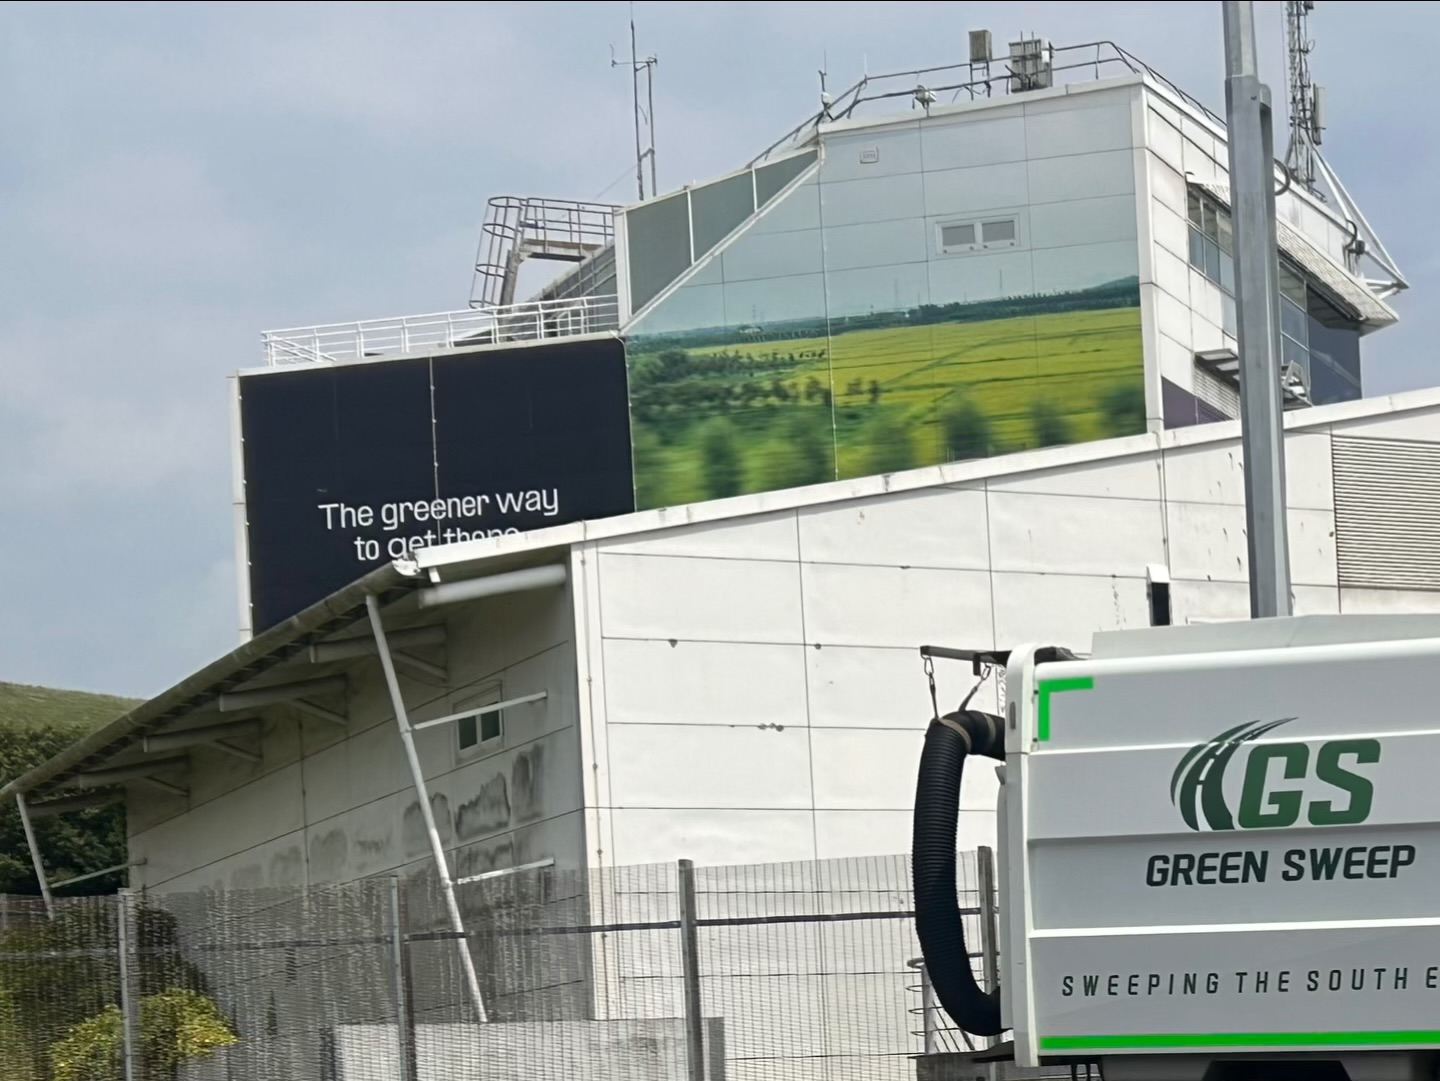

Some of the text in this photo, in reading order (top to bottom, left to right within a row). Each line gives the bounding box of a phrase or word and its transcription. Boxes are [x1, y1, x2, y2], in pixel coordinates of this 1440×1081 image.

[317, 488, 559, 531] The greener way
[353, 535, 380, 561] to
[1237, 738, 1382, 830] GS
[1145, 844, 1417, 887] GREEN SWEEP
[1061, 972, 1220, 998] SWEEPING
[1235, 970, 1291, 995] THE
[1306, 967, 1409, 993] SOUTH
